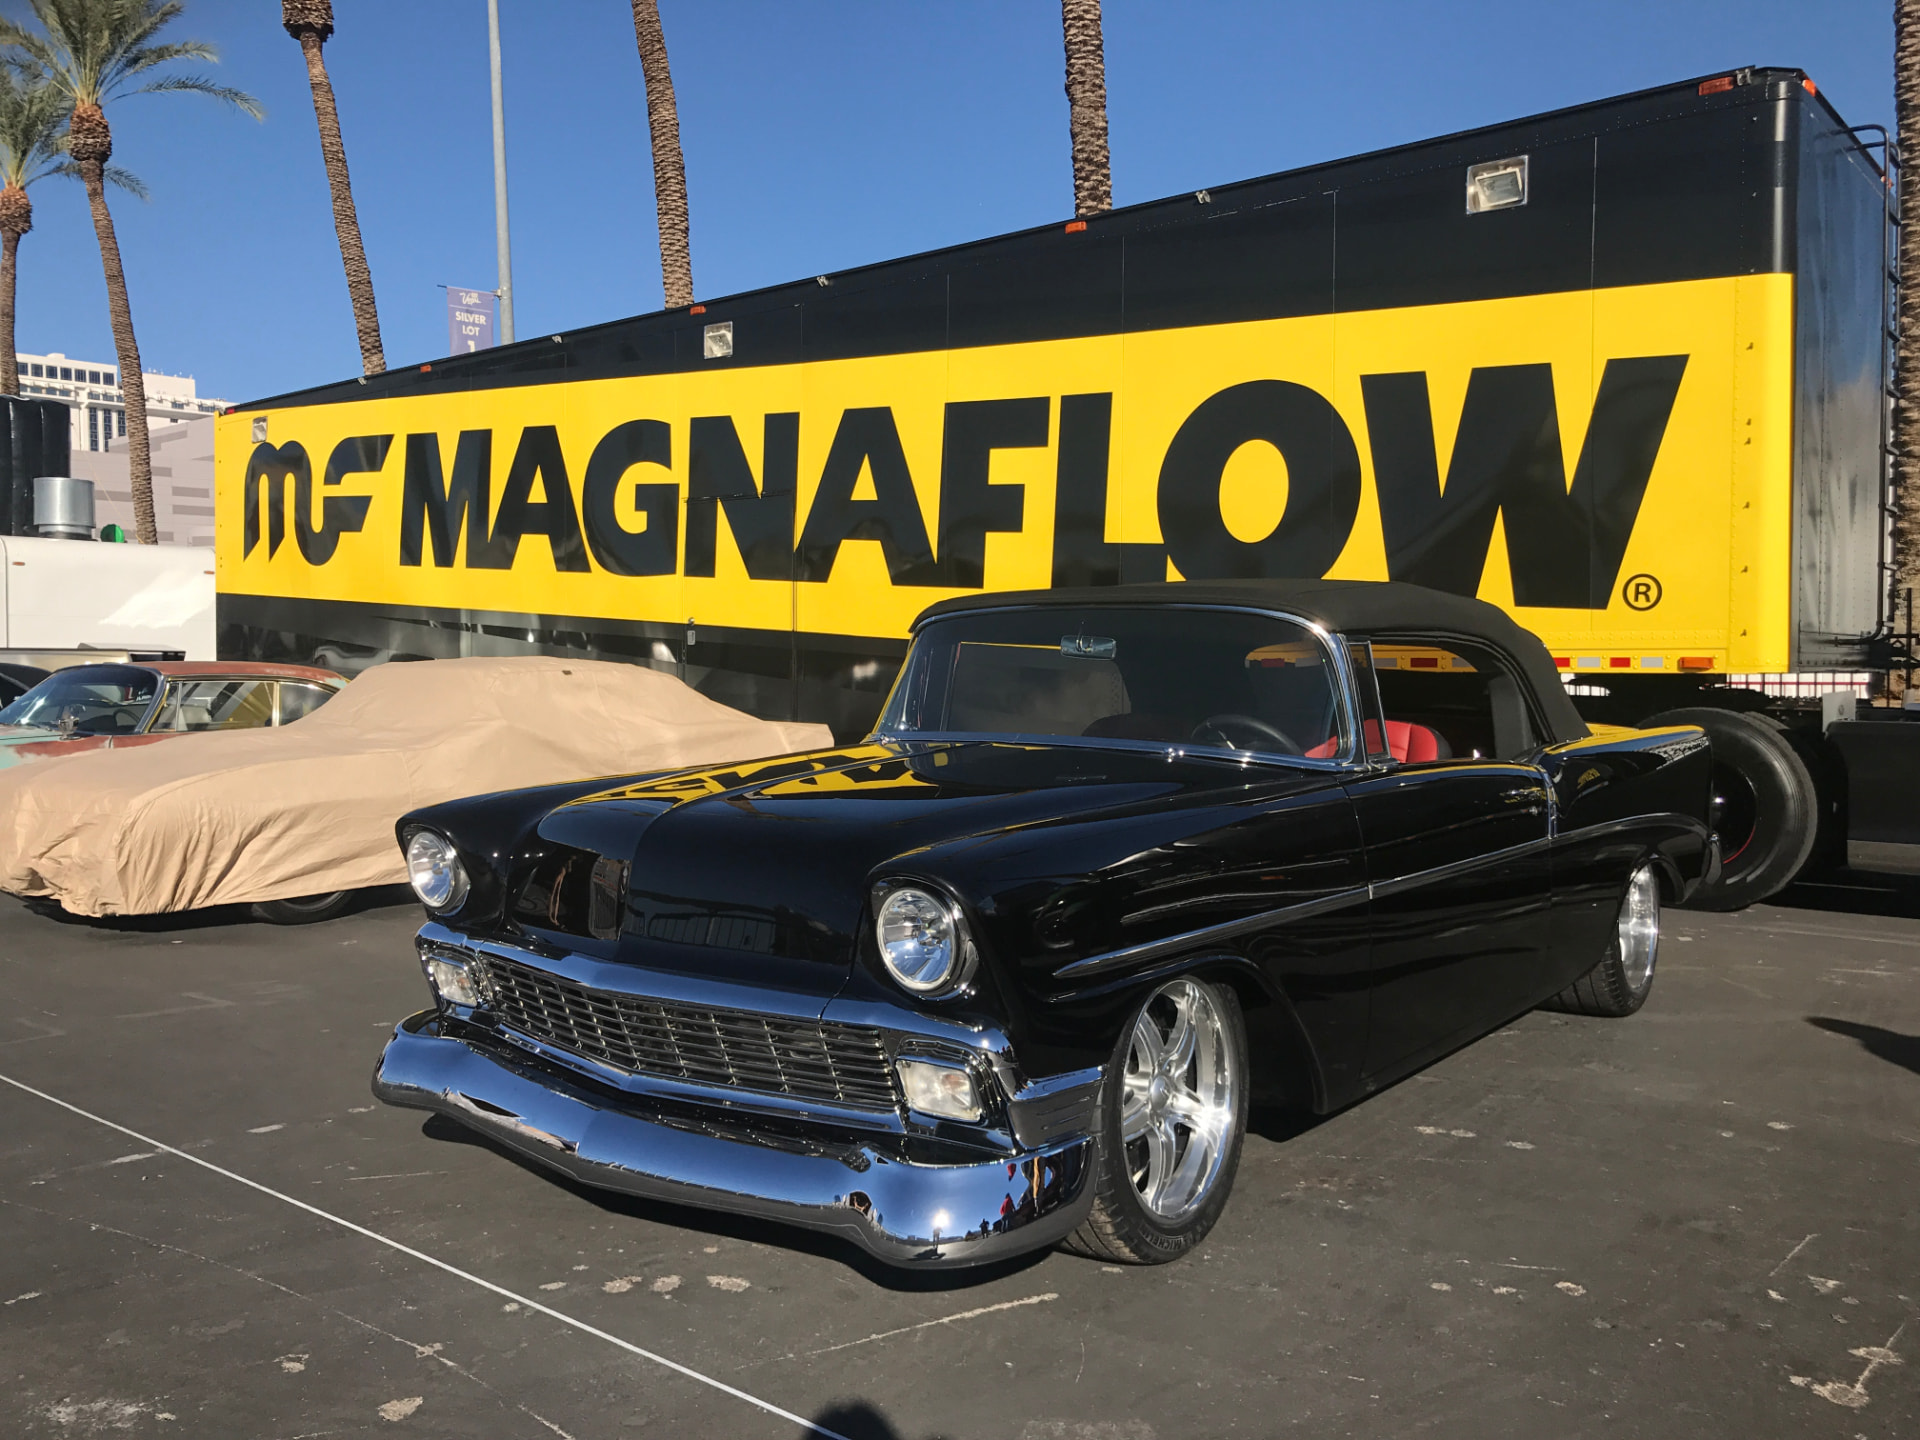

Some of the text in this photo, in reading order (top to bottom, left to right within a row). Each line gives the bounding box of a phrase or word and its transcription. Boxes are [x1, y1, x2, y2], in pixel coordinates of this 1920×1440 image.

[455, 311, 487, 325] SILVER
[462, 324, 480, 336] LOT
[399, 353, 1690, 610] MAGNAFLOW
